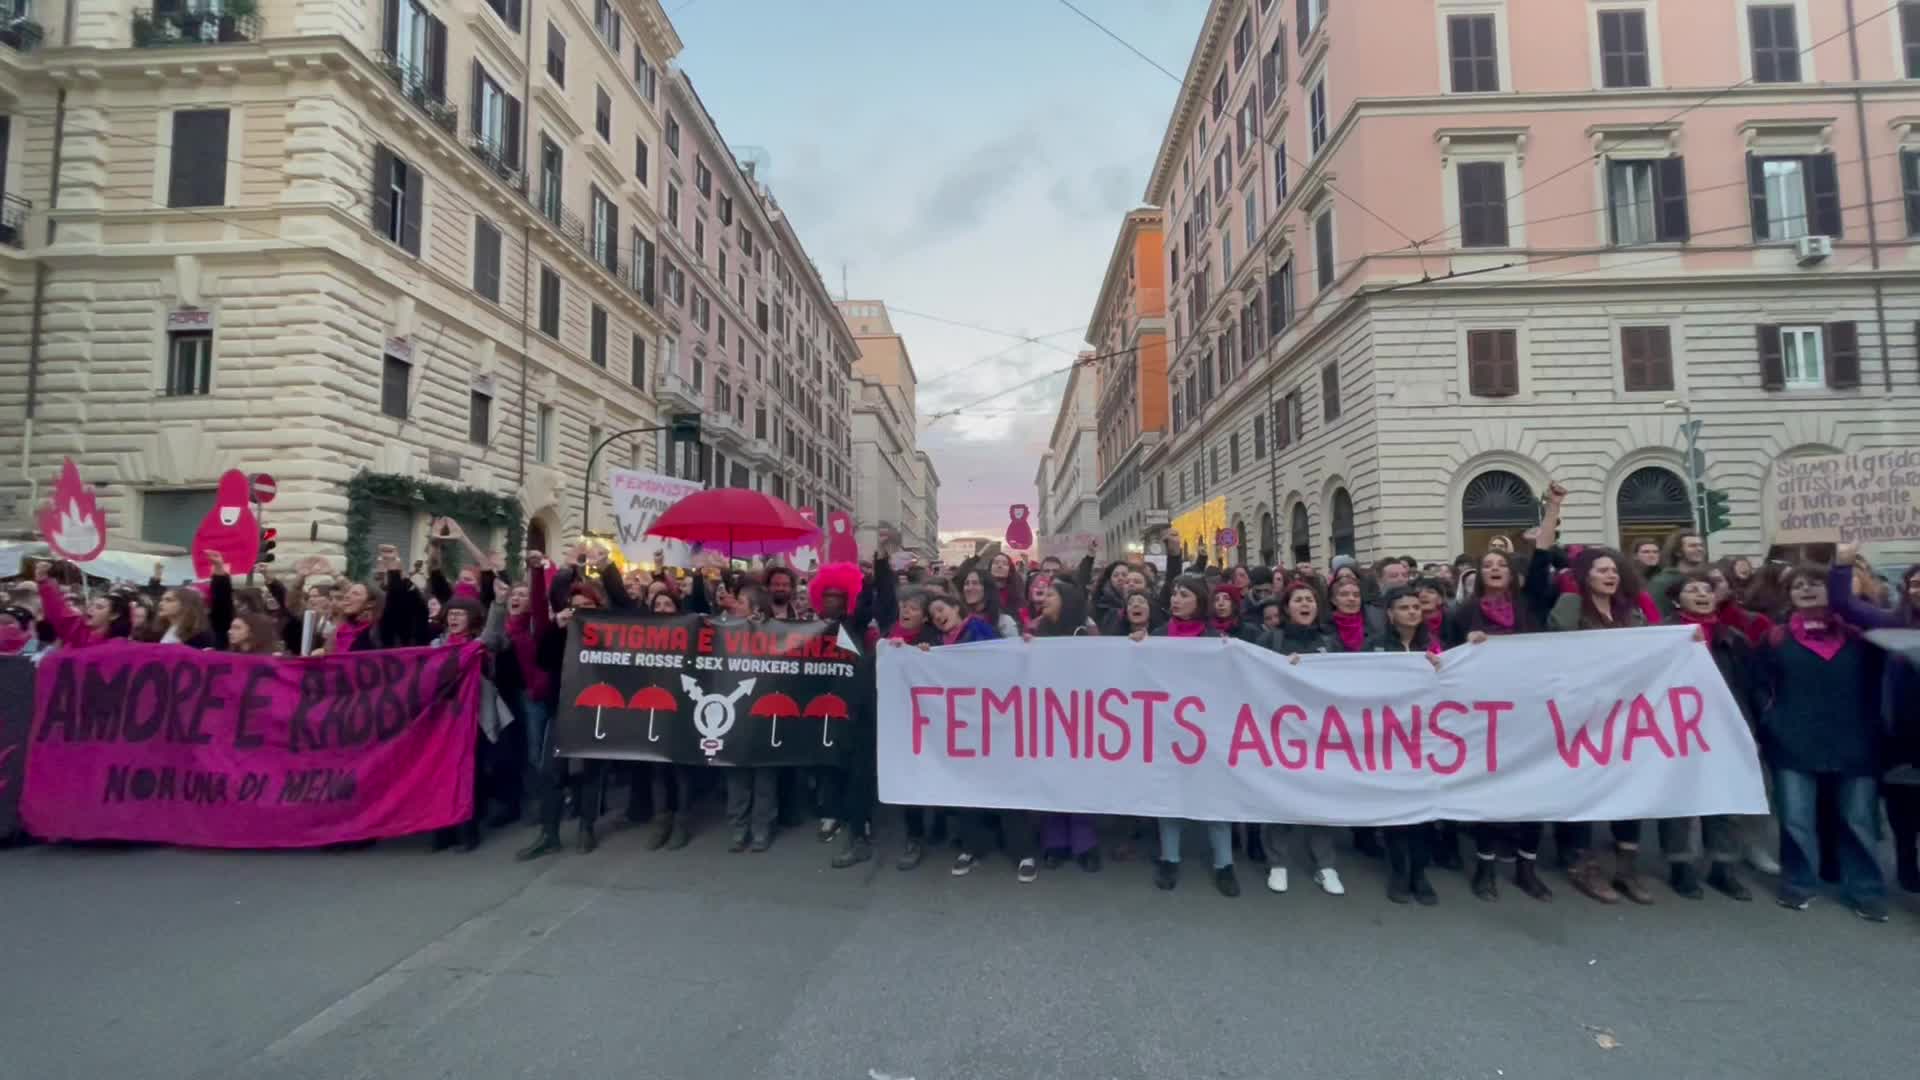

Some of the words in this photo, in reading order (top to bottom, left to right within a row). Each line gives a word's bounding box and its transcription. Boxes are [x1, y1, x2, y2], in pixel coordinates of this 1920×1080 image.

[630, 494, 673, 512] AGAIN
[582, 623, 688, 651] STIGMA
[579, 650, 631, 666] OMBRE
[635, 653, 683, 668] ROSSE
[695, 657, 723, 671] SEX
[728, 658, 799, 674] WORKERS
[804, 664, 854, 678] RIGHTS
[36, 657, 232, 744] AMORE
[233, 663, 278, 750] E
[911, 685, 1207, 766] FEMINISTS
[1228, 701, 1514, 775] AGAINST
[1547, 686, 1711, 768] WAR
